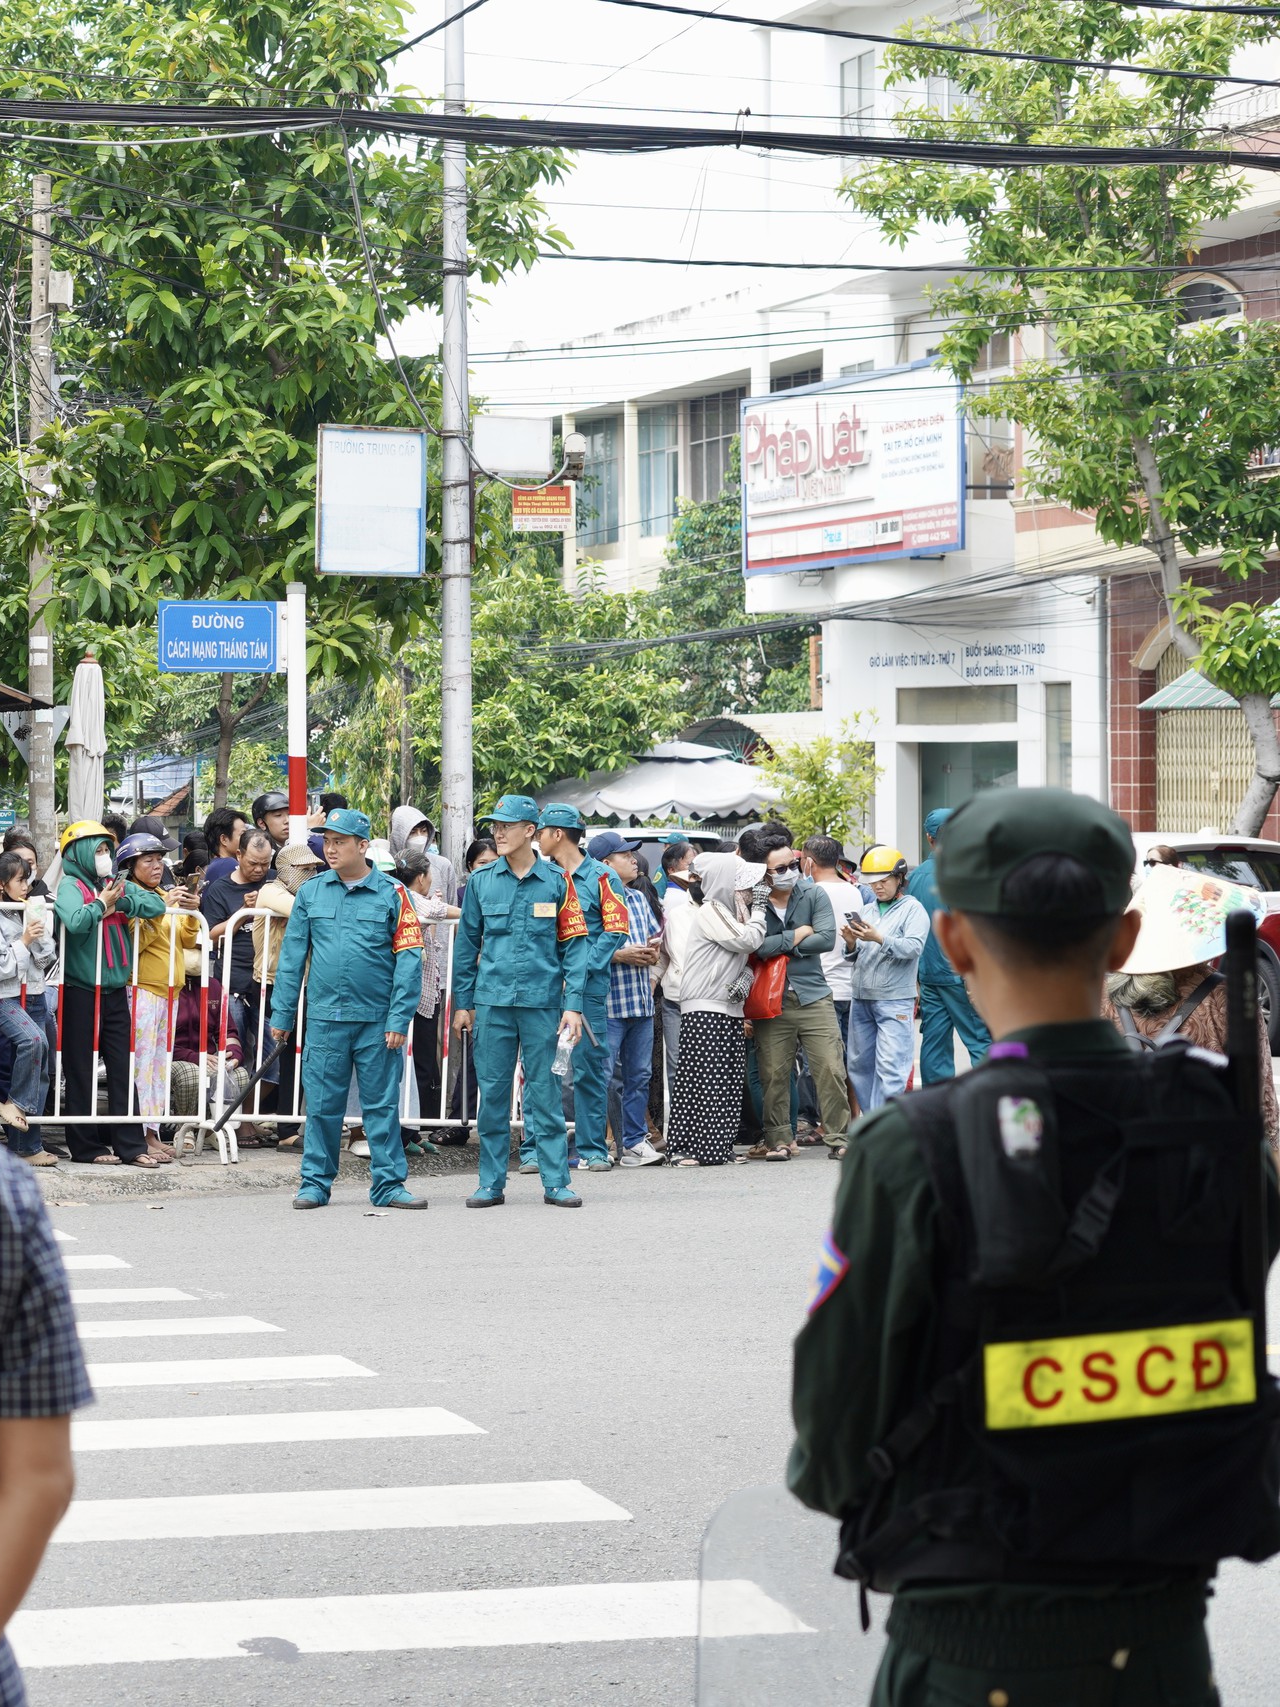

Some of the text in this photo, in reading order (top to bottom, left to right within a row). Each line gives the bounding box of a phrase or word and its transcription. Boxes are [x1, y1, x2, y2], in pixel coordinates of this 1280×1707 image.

[926, 432, 942, 444] MINH
[328, 438, 416, 457] TRƯỜNG TRUNG CẤP
[192, 611, 245, 629] ĐƯỜNG
[167, 637, 268, 662] CÁCH MẠNG THÁNG TÁM
[966, 640, 981, 657] BUỔI
[869, 652, 880, 667] GIỜ
[881, 652, 894, 667] LÀM
[919, 650, 930, 665] THỨ
[966, 661, 981, 677] BUỔI
[1022, 1339, 1229, 1410] CSCĐ
